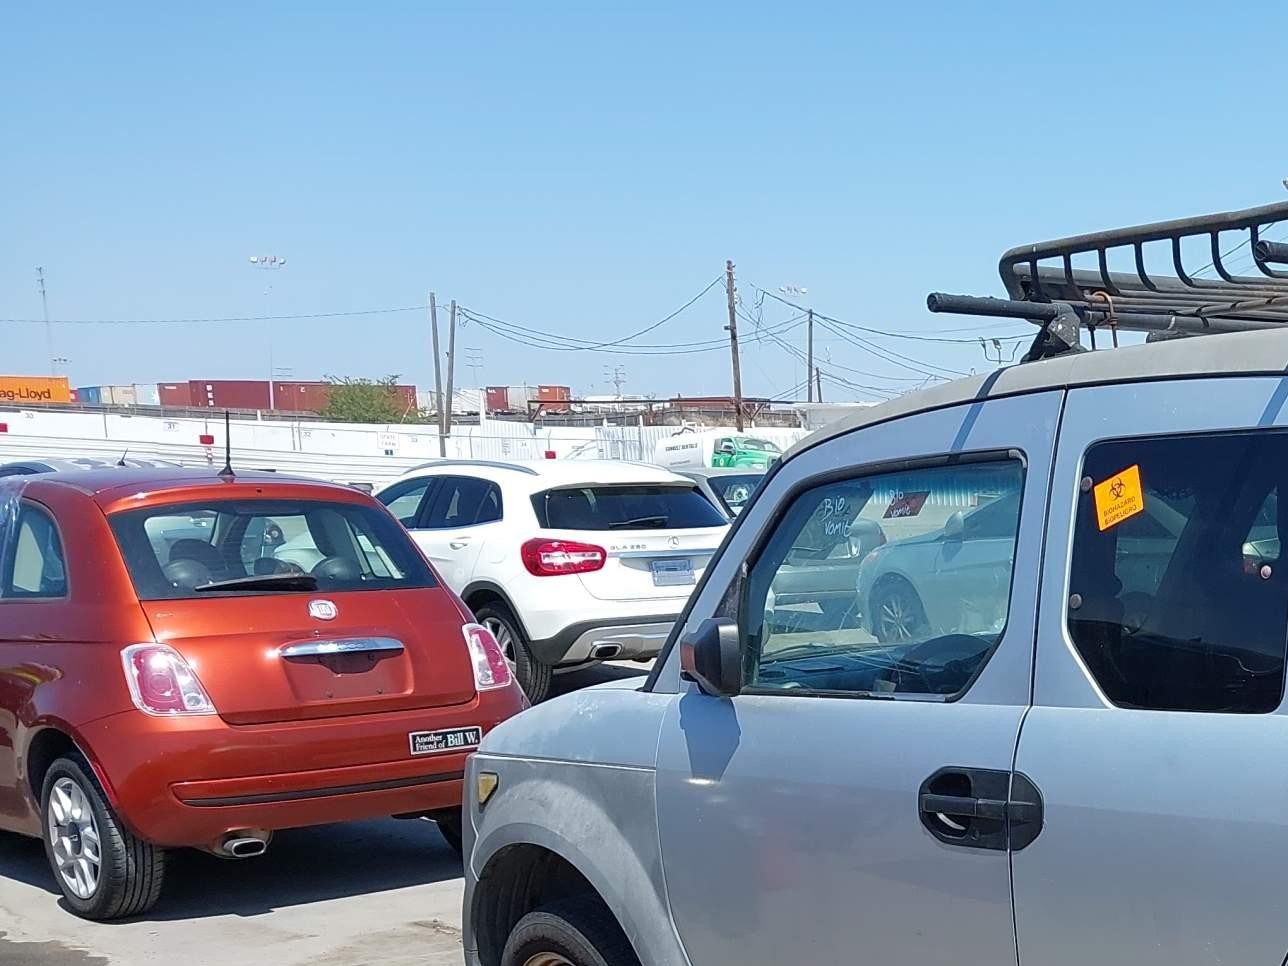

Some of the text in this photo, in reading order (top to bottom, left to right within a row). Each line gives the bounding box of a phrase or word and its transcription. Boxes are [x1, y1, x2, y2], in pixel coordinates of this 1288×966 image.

[415, 733, 442, 743] Another
[447, 731, 478, 746] Bill W.
[415, 740, 445, 751] Friend of
